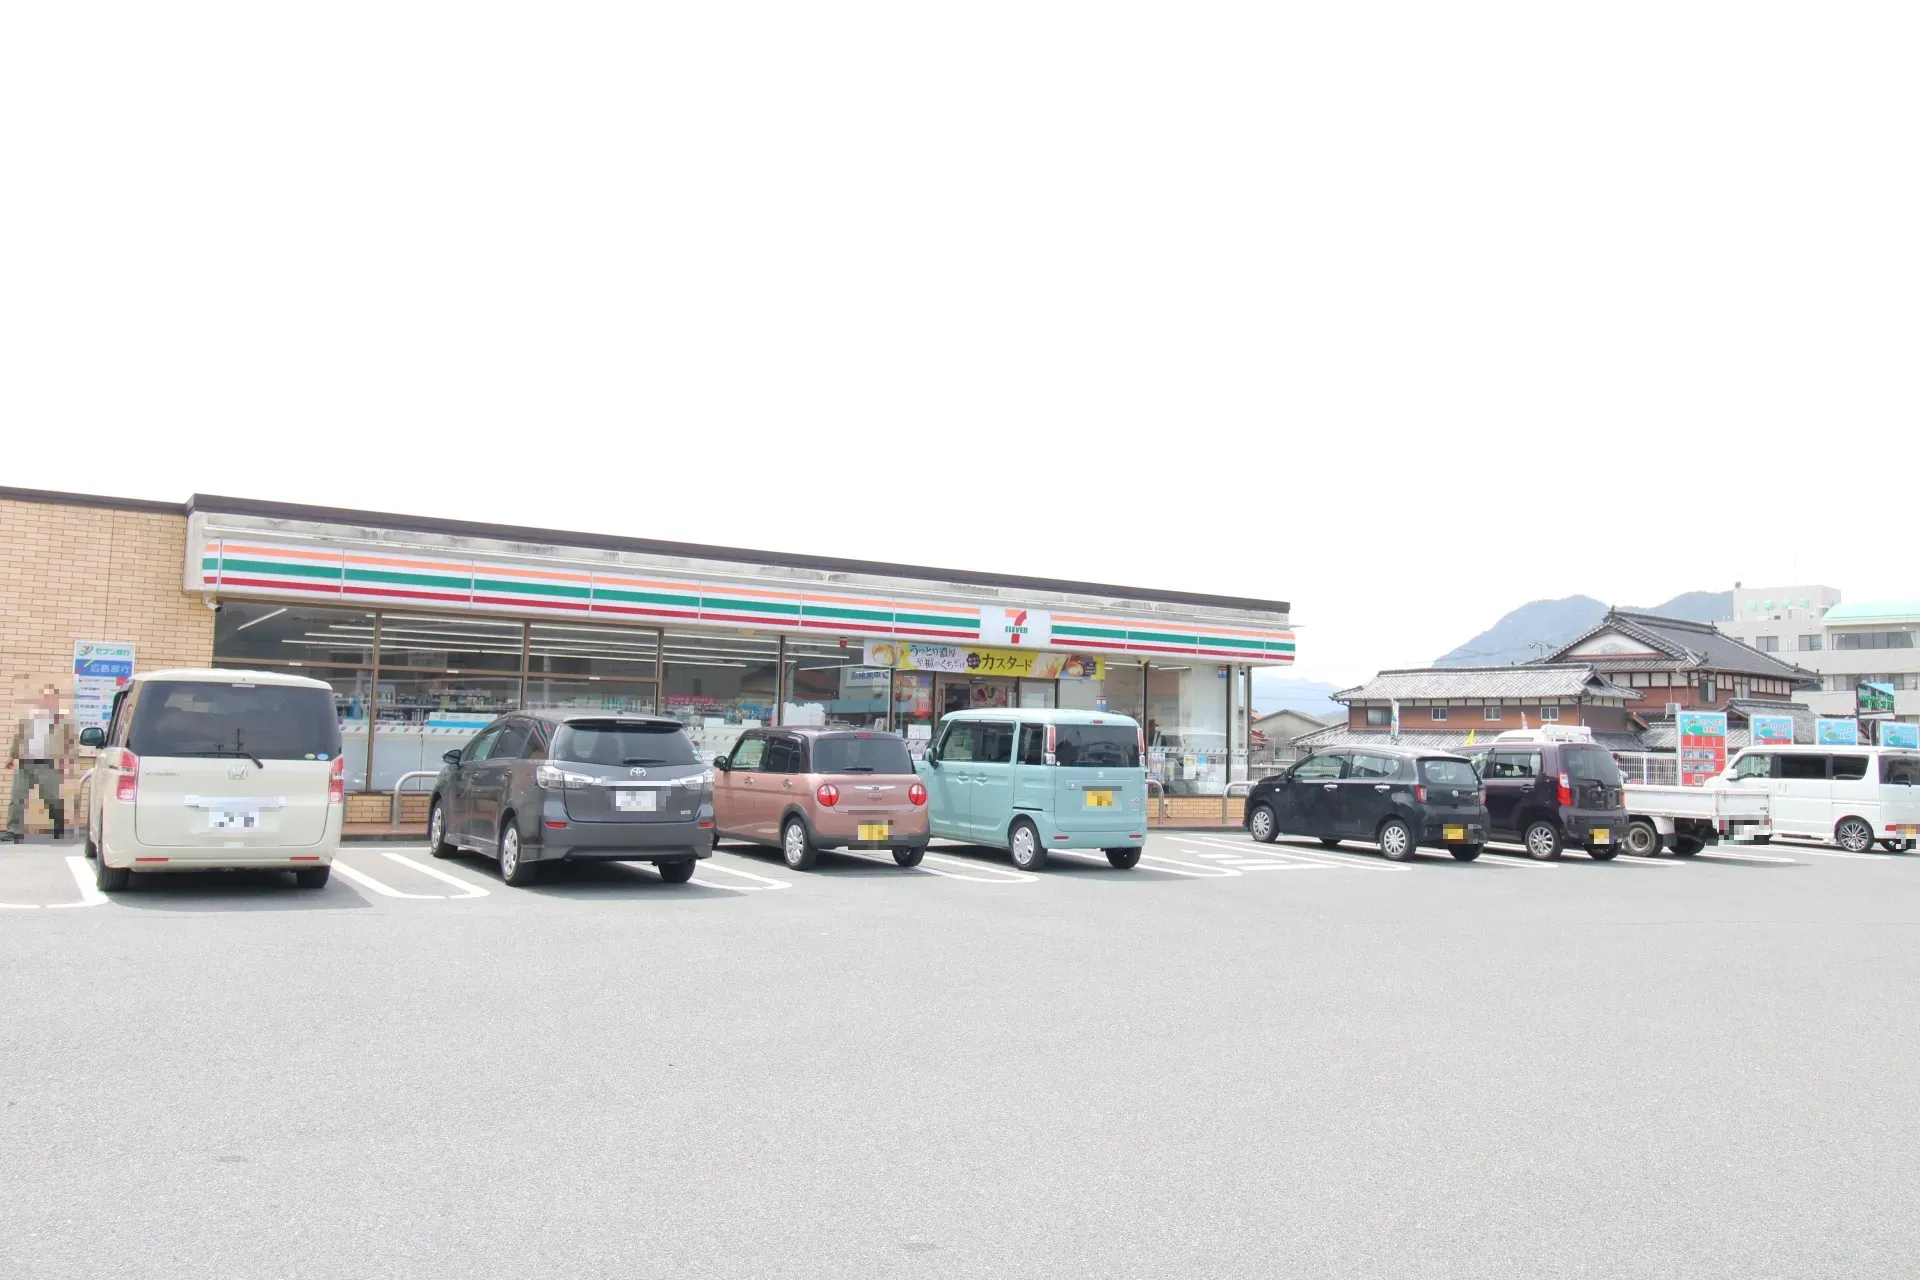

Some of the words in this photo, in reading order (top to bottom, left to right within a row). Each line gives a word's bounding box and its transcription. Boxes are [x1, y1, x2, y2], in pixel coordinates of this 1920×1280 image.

[95, 648, 130, 656] セブン銀行
[910, 644, 956, 658] うっとり濃厚
[916, 657, 966, 670] 至福のくちどけ
[981, 653, 1033, 671] カスタード
[90, 664, 130, 674] 広島銀行
